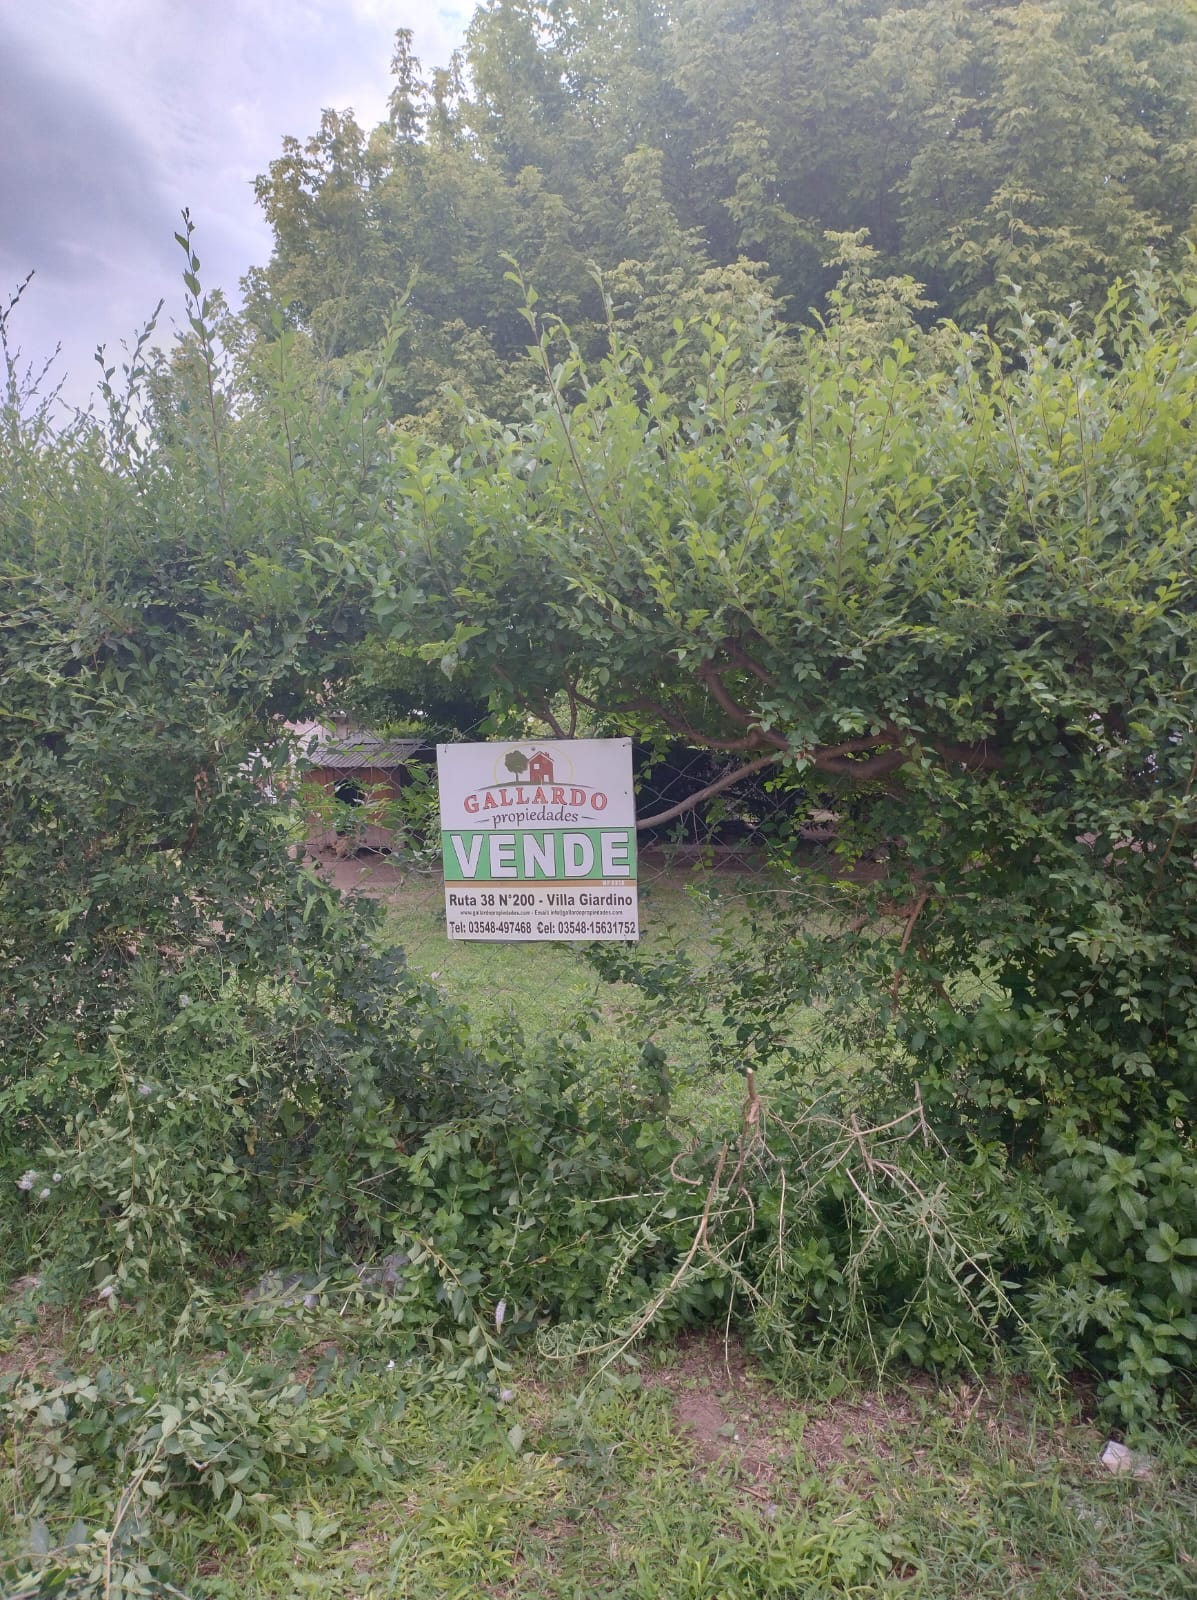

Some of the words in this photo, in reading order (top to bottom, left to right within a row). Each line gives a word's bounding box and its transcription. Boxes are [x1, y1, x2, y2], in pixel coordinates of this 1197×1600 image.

[464, 786, 608, 814] GALLARDO
[492, 805, 579, 829] propiedades
[450, 832, 631, 878] VENDE
[449, 894, 477, 906] Ruta
[481, 894, 495, 906] 38
[547, 893, 575, 906] Villa
[579, 893, 633, 906] Giardino
[449, 921, 466, 933] Tel:
[468, 921, 532, 934] 03548-497468
[537, 921, 555, 934] Cel:
[558, 921, 636, 934] 03548-15631752
